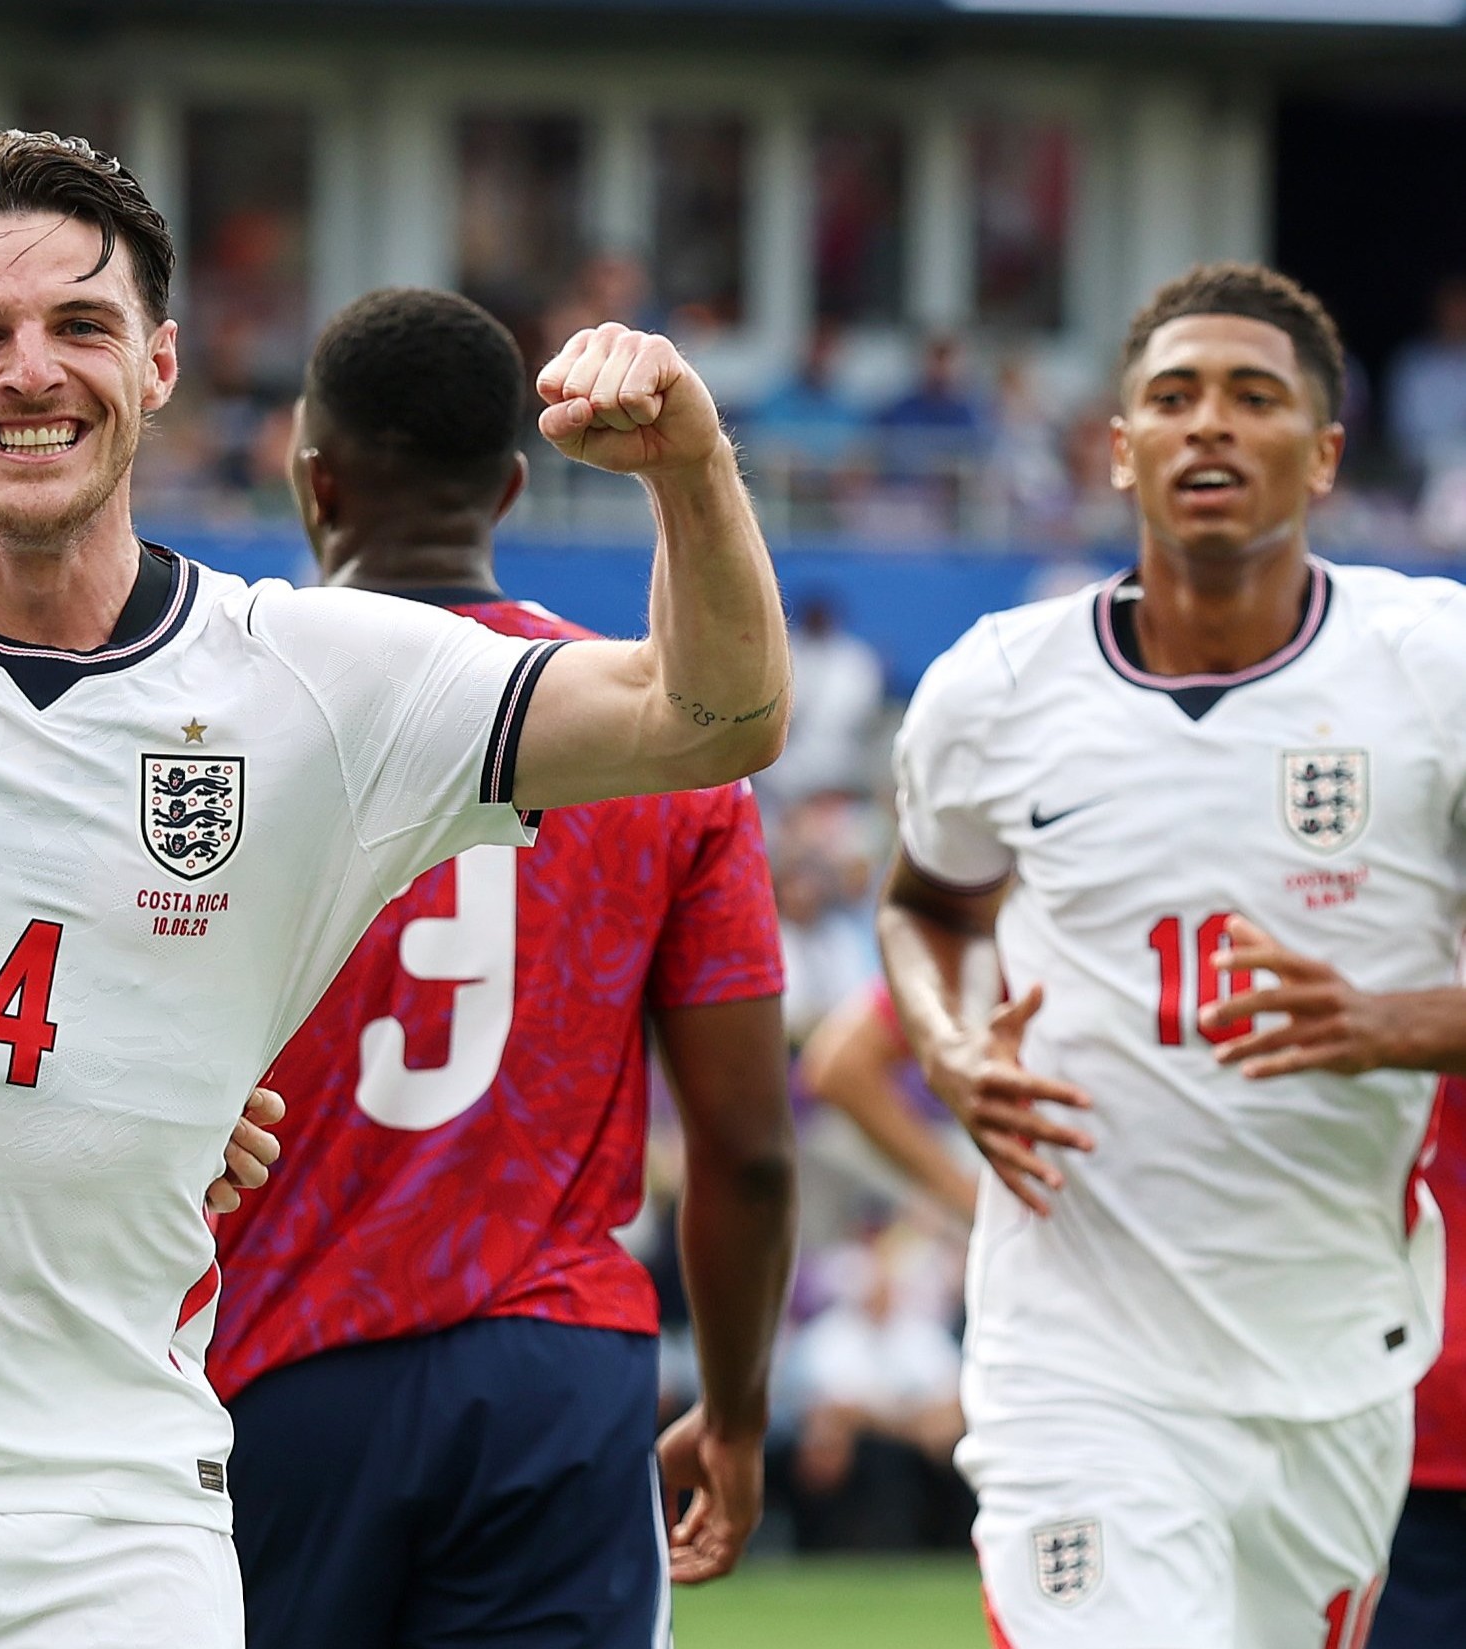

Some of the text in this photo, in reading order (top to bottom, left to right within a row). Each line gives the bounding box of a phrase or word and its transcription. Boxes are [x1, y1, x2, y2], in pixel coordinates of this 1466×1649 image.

[137, 889, 229, 913] COSTA RICA
[152, 916, 208, 937] 10.06.26
